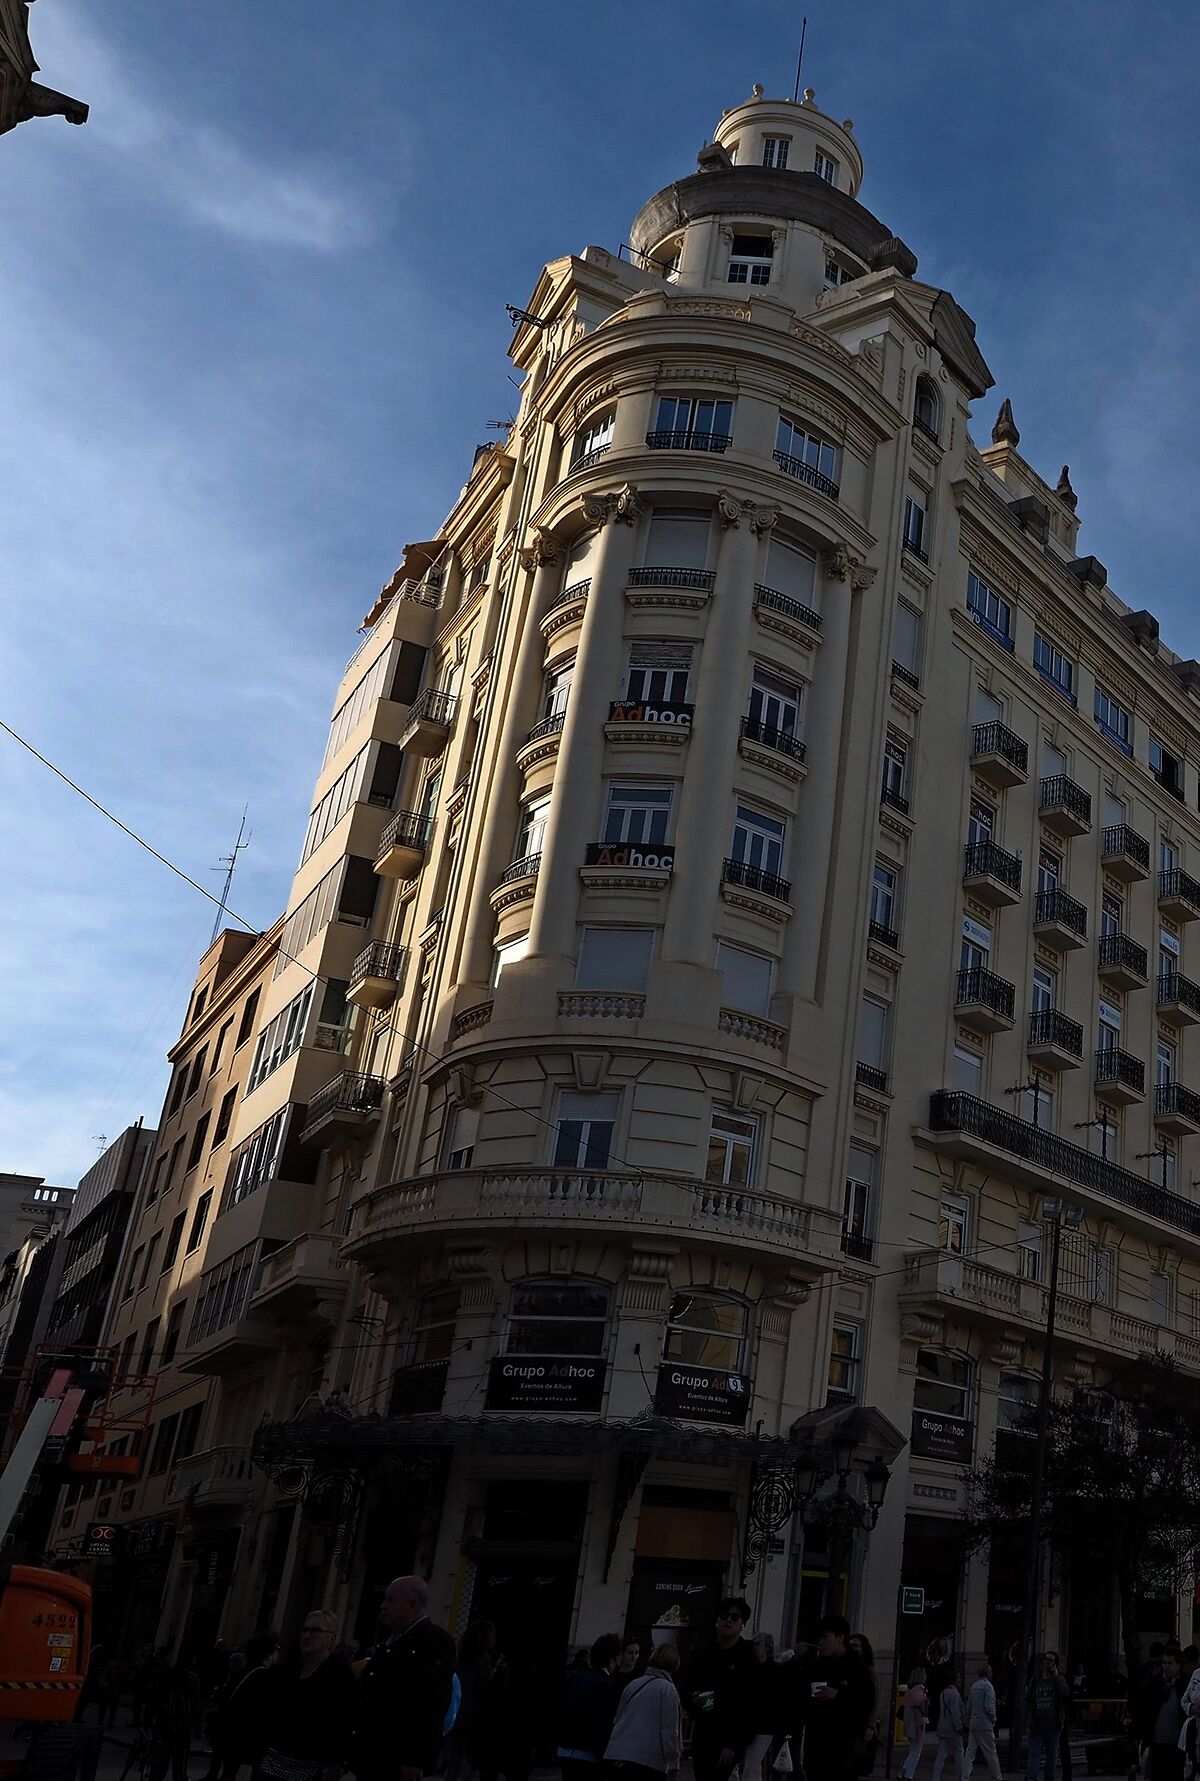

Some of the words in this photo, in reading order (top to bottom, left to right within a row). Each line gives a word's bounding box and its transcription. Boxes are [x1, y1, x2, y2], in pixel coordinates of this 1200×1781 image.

[611, 705, 692, 725] Adhoc
[596, 848, 674, 871] Adhoc
[503, 1365, 545, 1379] Grupo
[548, 1365, 595, 1377] Adhoc
[671, 1372, 709, 1390] Grupo
[922, 1418, 943, 1434] Grupo
[32, 1613, 76, 1627] 4522
